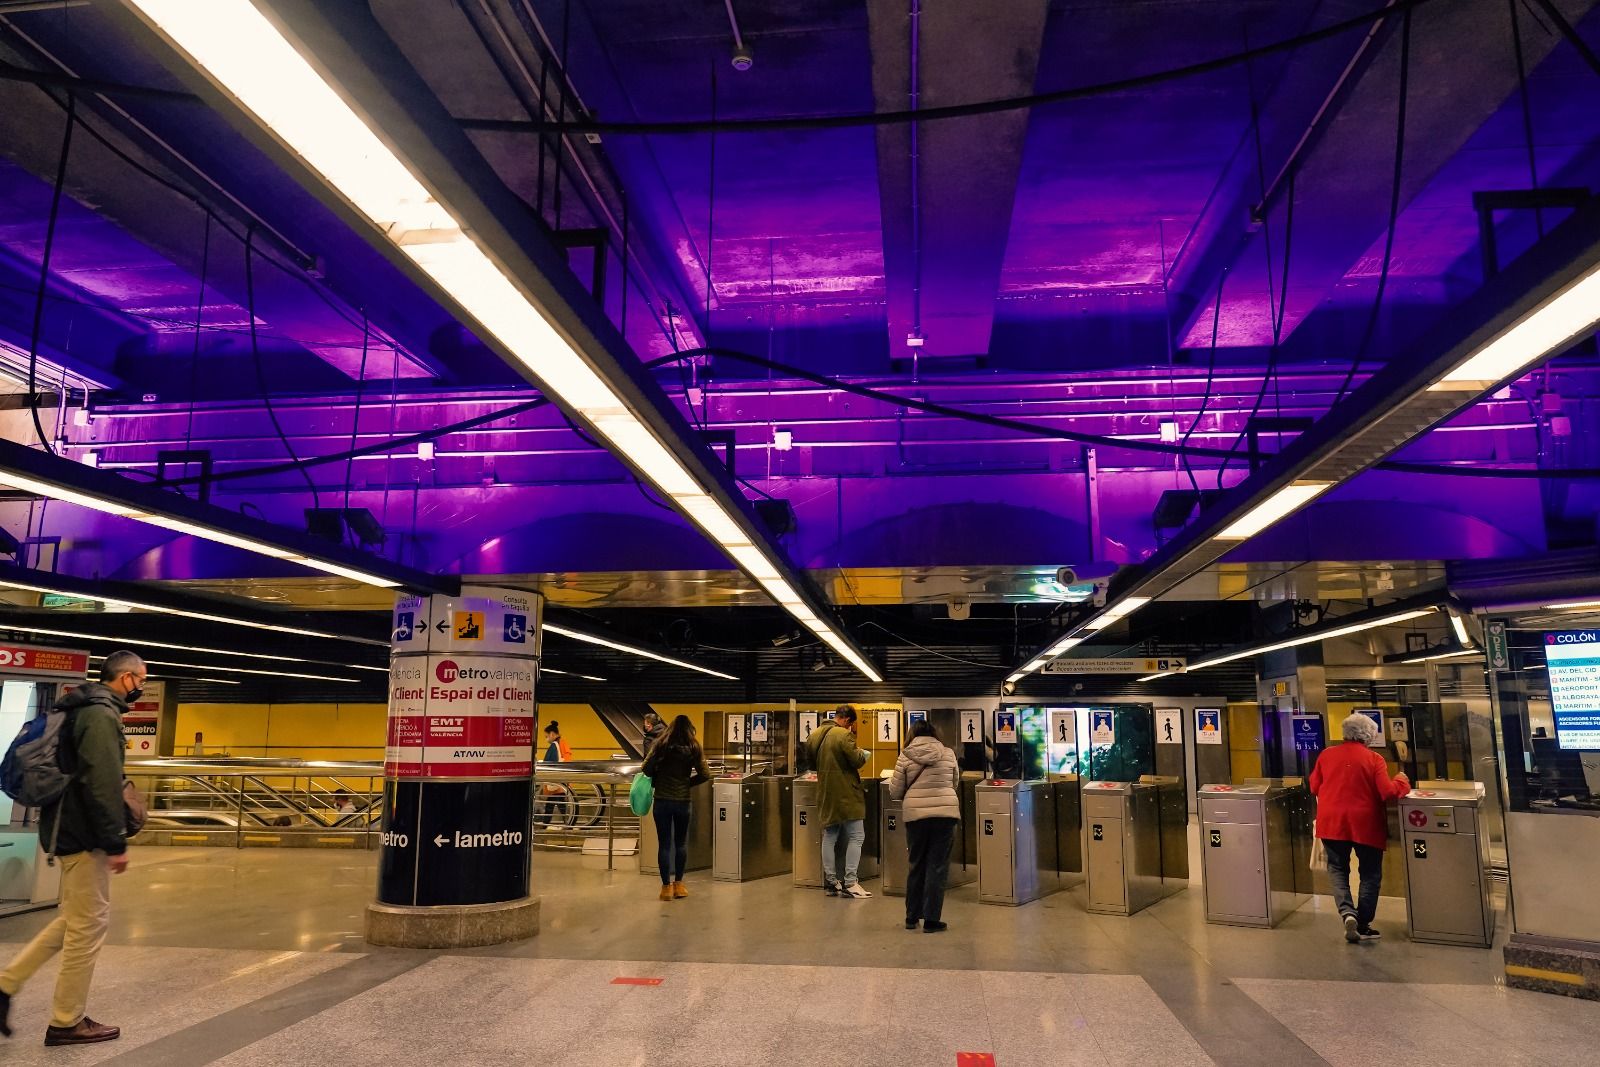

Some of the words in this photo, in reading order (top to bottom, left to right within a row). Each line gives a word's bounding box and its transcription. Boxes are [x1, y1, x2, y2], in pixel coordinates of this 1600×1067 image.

[1557, 632, 1596, 643] COLÓN
[1493, 636, 1503, 659] DEA
[441, 665, 531, 681] metrovalencia
[430, 686, 473, 702] Espai
[477, 687, 499, 700] del
[503, 688, 532, 701] Client
[430, 718, 464, 726] EMT
[453, 750, 485, 758] ATMV
[454, 829, 522, 848] lametro
